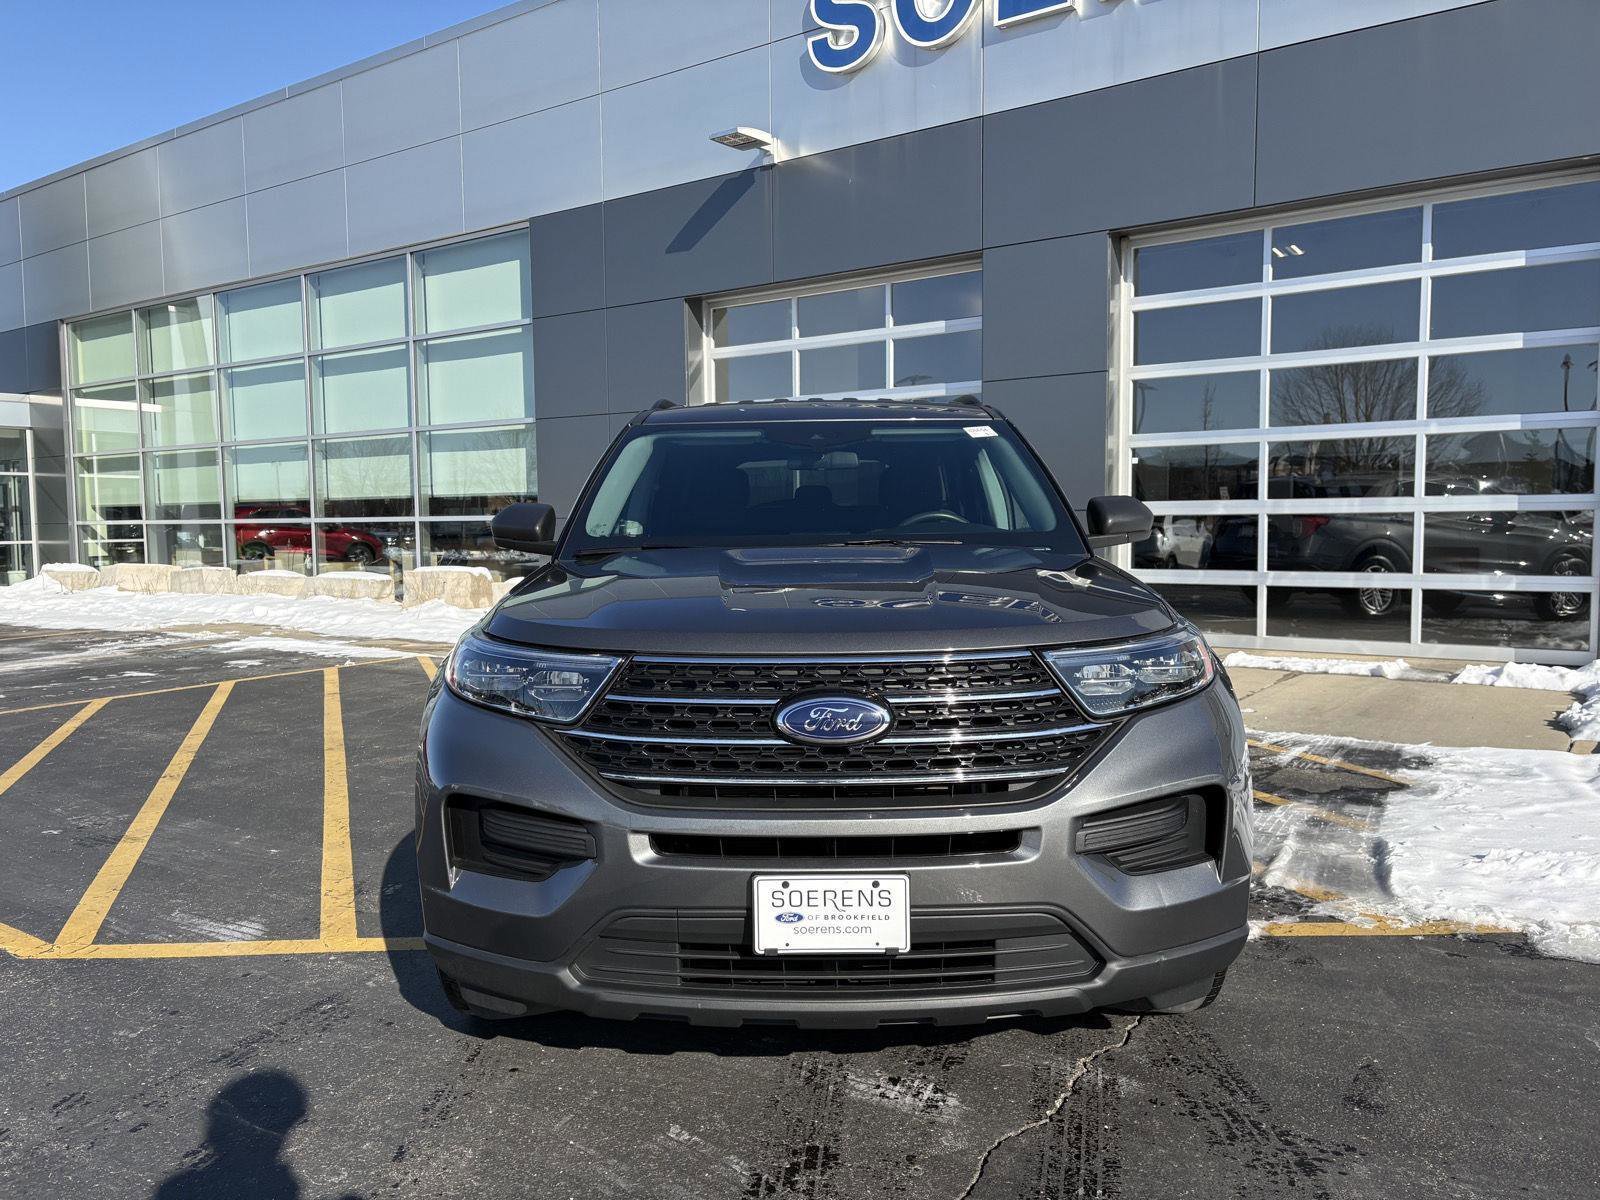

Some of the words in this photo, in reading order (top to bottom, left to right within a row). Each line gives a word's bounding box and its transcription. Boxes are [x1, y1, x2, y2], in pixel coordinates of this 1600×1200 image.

[804, 706, 864, 732] Ford
[771, 889, 892, 912] SOERENS
[793, 925, 872, 935] soerens.com
